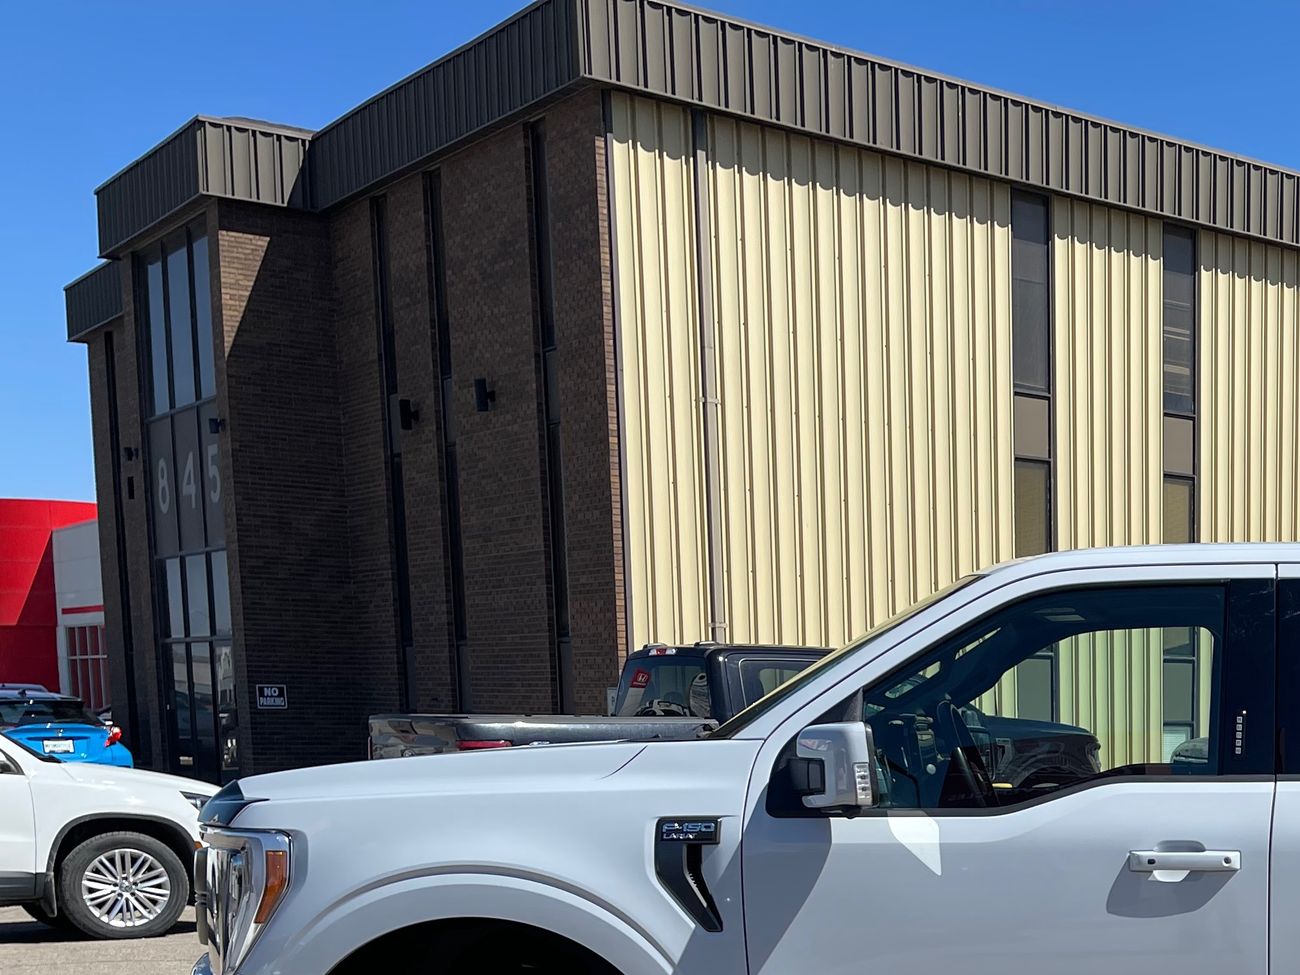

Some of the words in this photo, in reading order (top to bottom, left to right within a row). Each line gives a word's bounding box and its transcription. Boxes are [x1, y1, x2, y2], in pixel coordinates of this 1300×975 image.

[158, 444, 220, 514] 845
[264, 687, 279, 697] NO
[662, 822, 716, 833] F-150
